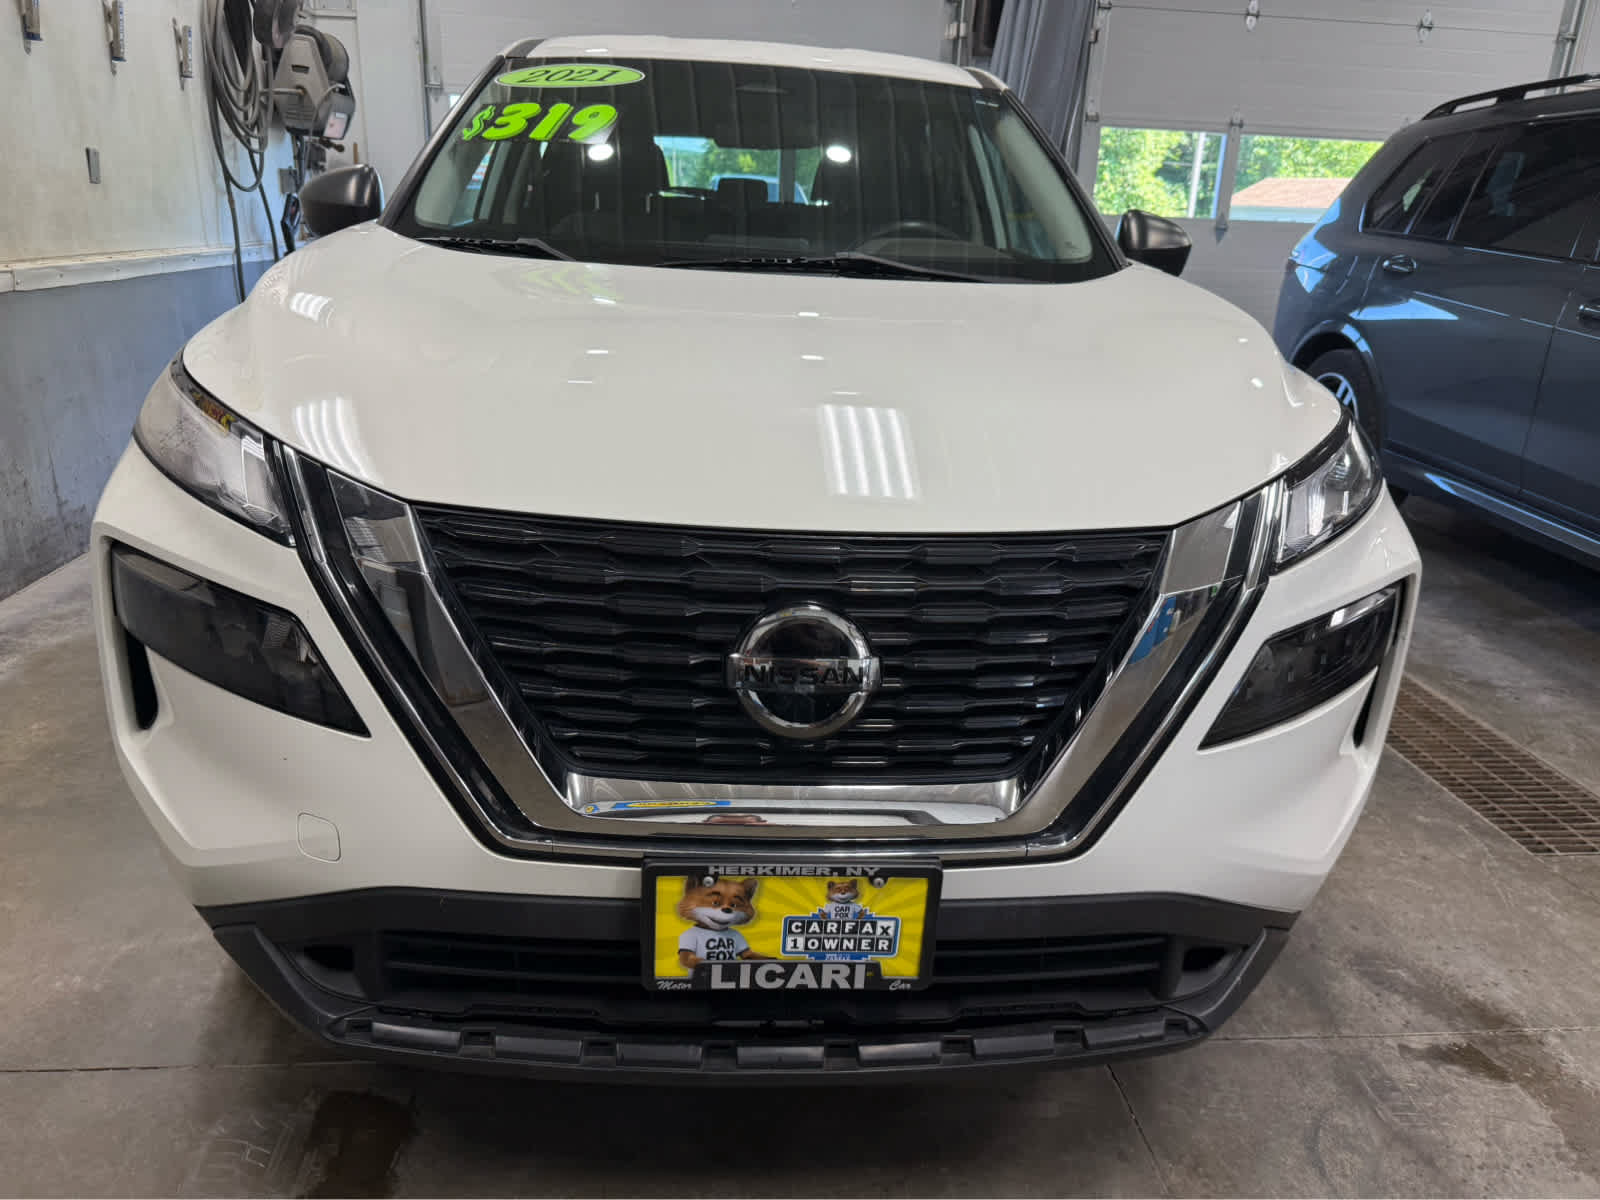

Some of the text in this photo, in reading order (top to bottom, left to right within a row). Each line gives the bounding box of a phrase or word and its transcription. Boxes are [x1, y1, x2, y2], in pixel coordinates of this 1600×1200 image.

[517, 69, 620, 83] 2021
[462, 102, 618, 142] $319
[744, 664, 864, 684] NISSAN
[846, 867, 881, 877] NY
[790, 921, 891, 936] CARFAX
[705, 938, 735, 951] CAR
[790, 938, 889, 951] 1 OWNER
[706, 951, 735, 961] FOX
[656, 963, 912, 991] Motor LICARI Car
